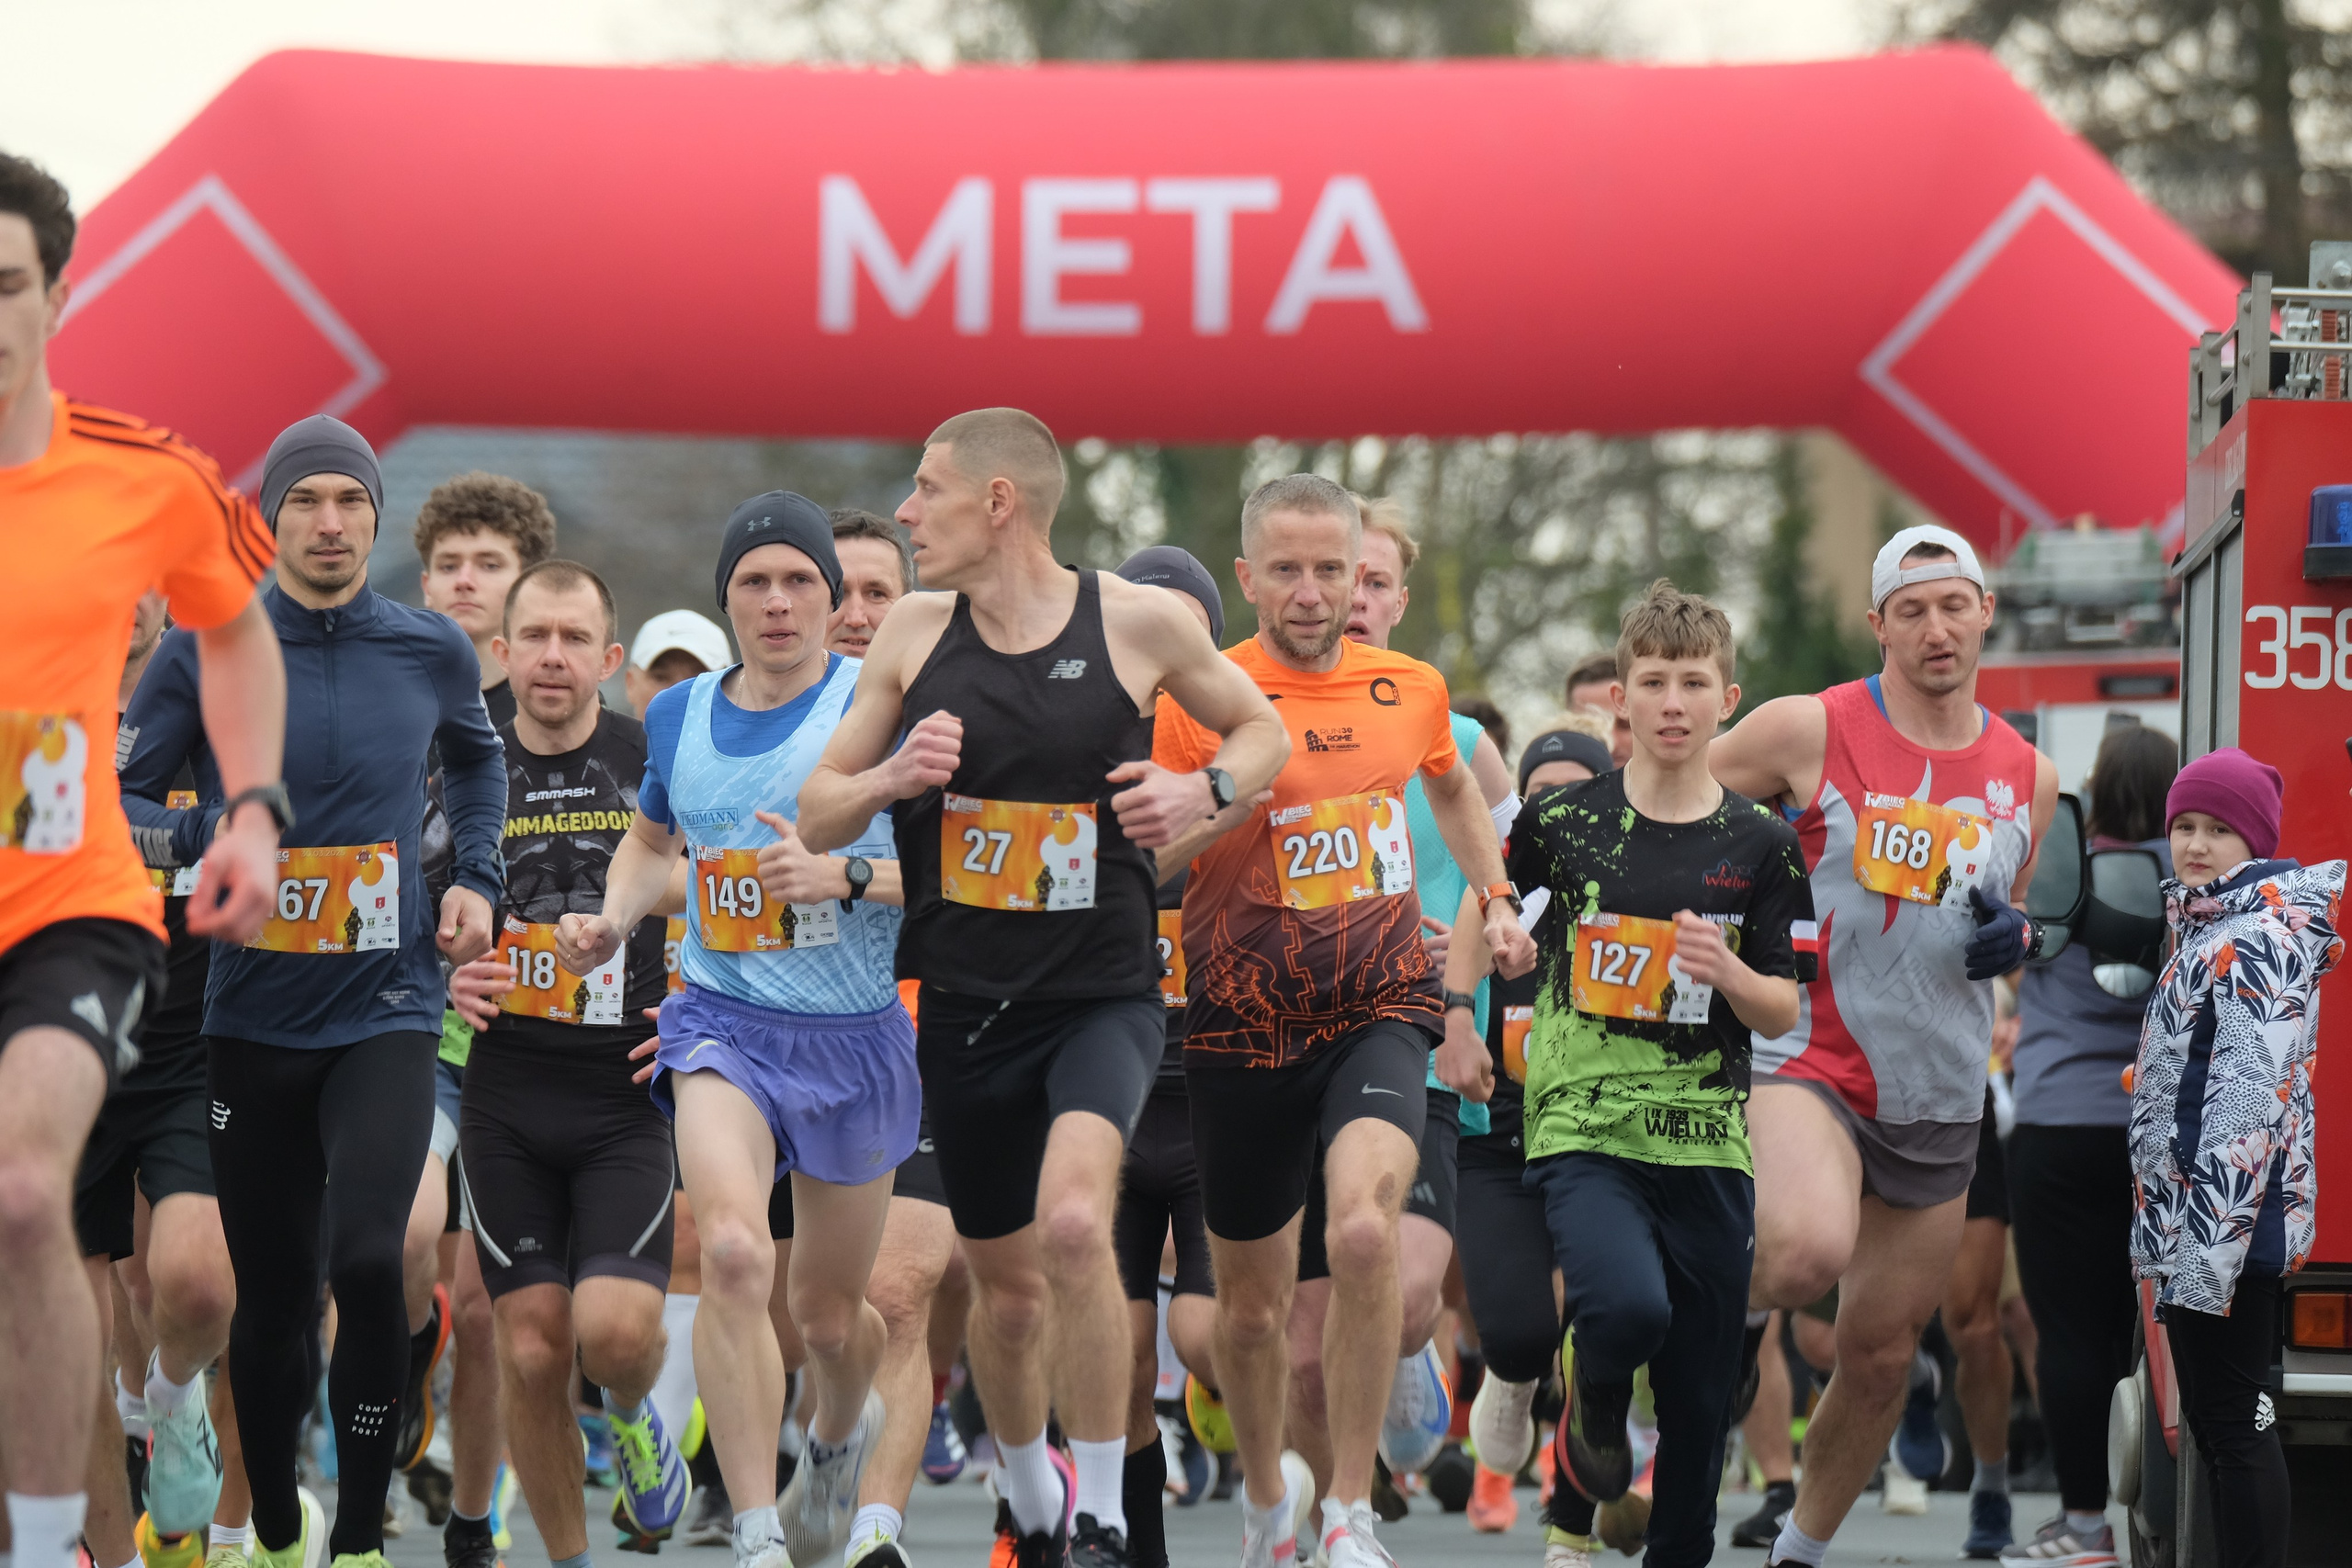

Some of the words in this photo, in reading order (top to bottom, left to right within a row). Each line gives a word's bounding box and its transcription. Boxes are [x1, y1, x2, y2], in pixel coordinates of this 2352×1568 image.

[817, 174, 1431, 336] META
[525, 787, 596, 802] SMMASH
[1883, 794, 1905, 805] BIEG
[958, 795, 983, 809] BIEG
[1287, 805, 1312, 816] BIEG
[505, 809, 636, 839] NMAGEDDON
[707, 846, 724, 855] BIEG
[963, 828, 1012, 874] 27
[1871, 820, 1932, 870] 168
[275, 851, 289, 860] EG
[1283, 827, 1360, 879] 220
[706, 874, 763, 918] 149
[1352, 885, 1374, 898] 5KM
[1910, 886, 1932, 902] 5KM
[266, 878, 329, 921] 67
[1007, 894, 1035, 908] 5KM
[318, 939, 345, 952] 5KM
[756, 933, 782, 947] 5KM
[507, 945, 556, 990] 118
[1590, 939, 1652, 987] 127
[1164, 992, 1188, 1005] 5KM
[548, 1006, 572, 1019] 5KM
[1633, 1004, 1657, 1019] 5KM
[1666, 1109, 1689, 1121] 1939
[358, 1403, 389, 1413] COMP
[351, 1425, 379, 1437] PORT
